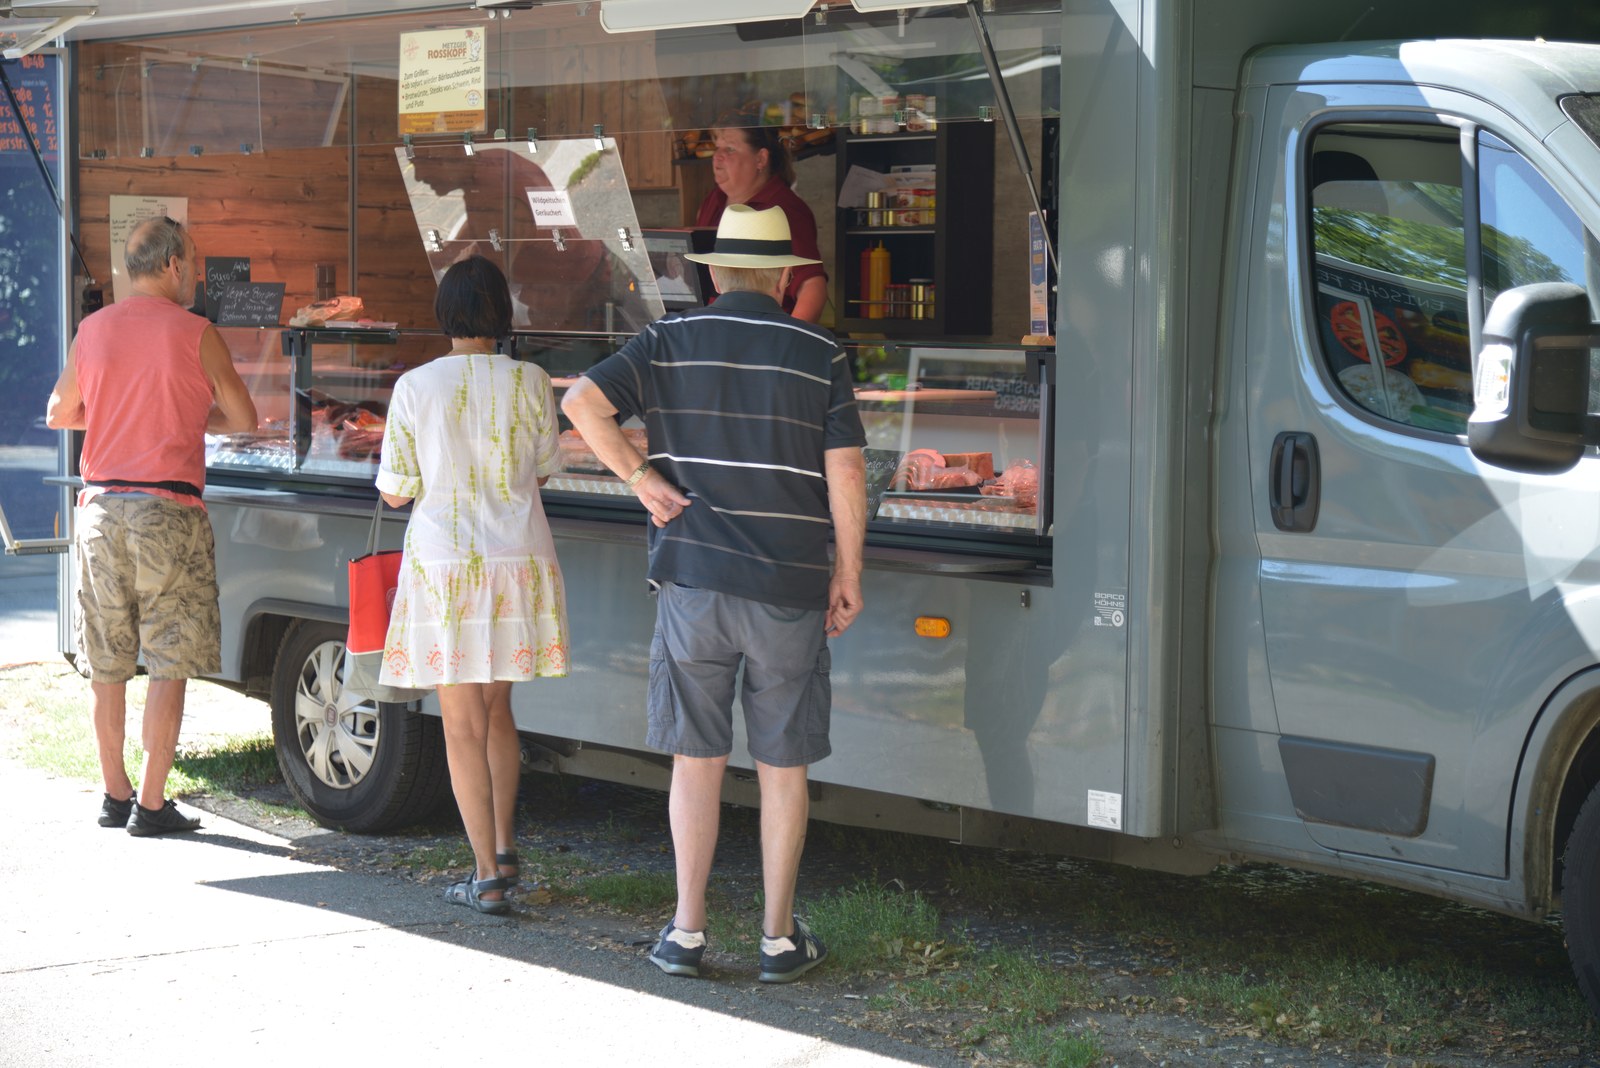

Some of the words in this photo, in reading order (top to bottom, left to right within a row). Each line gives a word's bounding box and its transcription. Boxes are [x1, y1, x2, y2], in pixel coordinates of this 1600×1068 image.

[442, 41, 467, 49] METZGER
[428, 48, 467, 59] ROSSKOPF
[411, 80, 423, 89] sofort
[1094, 592, 1125, 601] BORCO
[1094, 598, 1125, 607] HÖHNS
